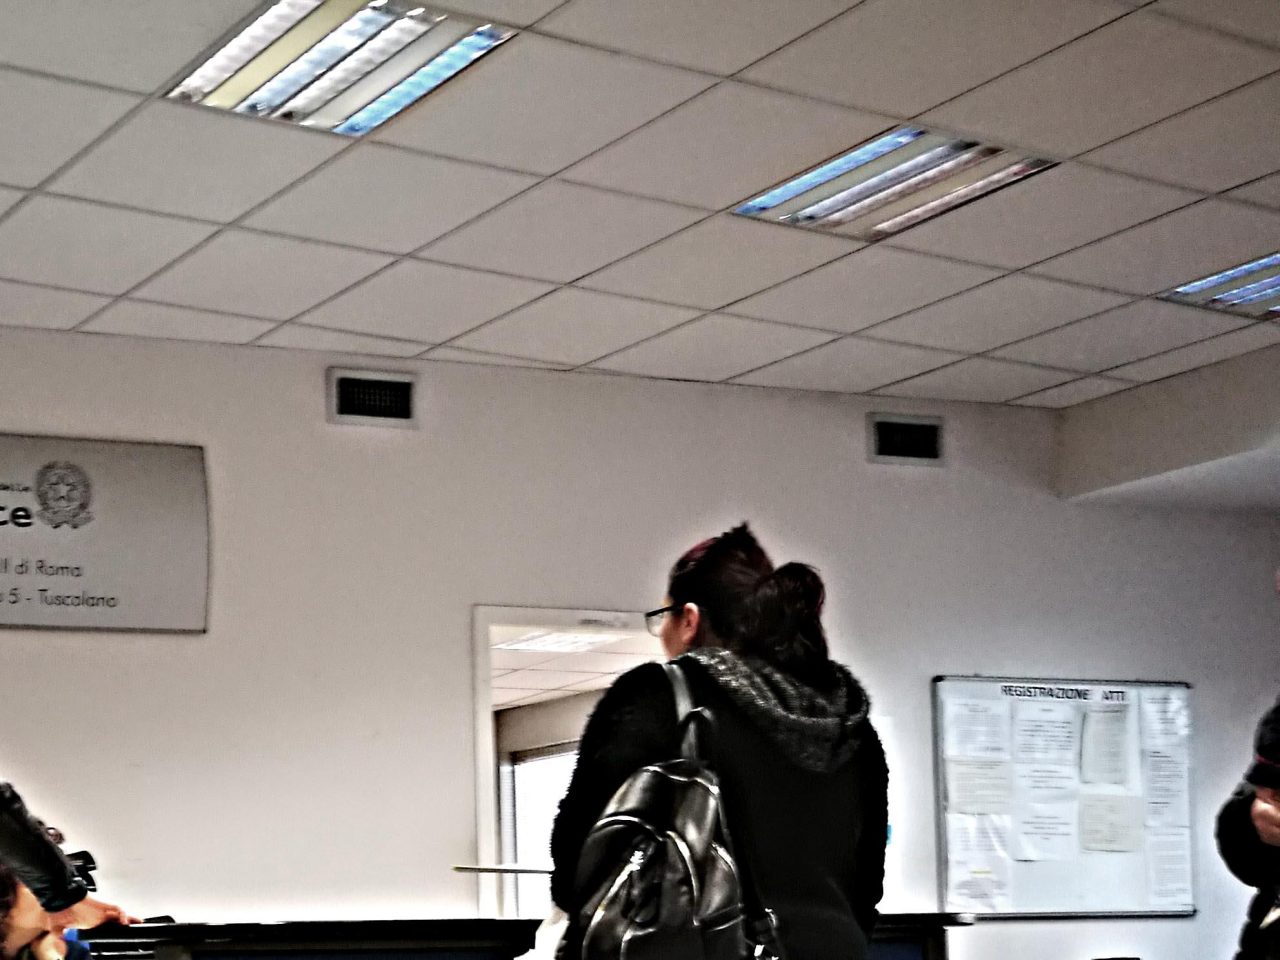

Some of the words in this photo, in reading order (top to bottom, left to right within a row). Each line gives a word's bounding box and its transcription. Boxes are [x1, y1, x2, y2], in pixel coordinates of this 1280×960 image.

[14, 556, 30, 577] di
[35, 561, 83, 579] Roma
[8, 588, 20, 606] 5
[36, 588, 119, 609] Tuscolano
[1000, 684, 1090, 702] REGISTRAZIONE
